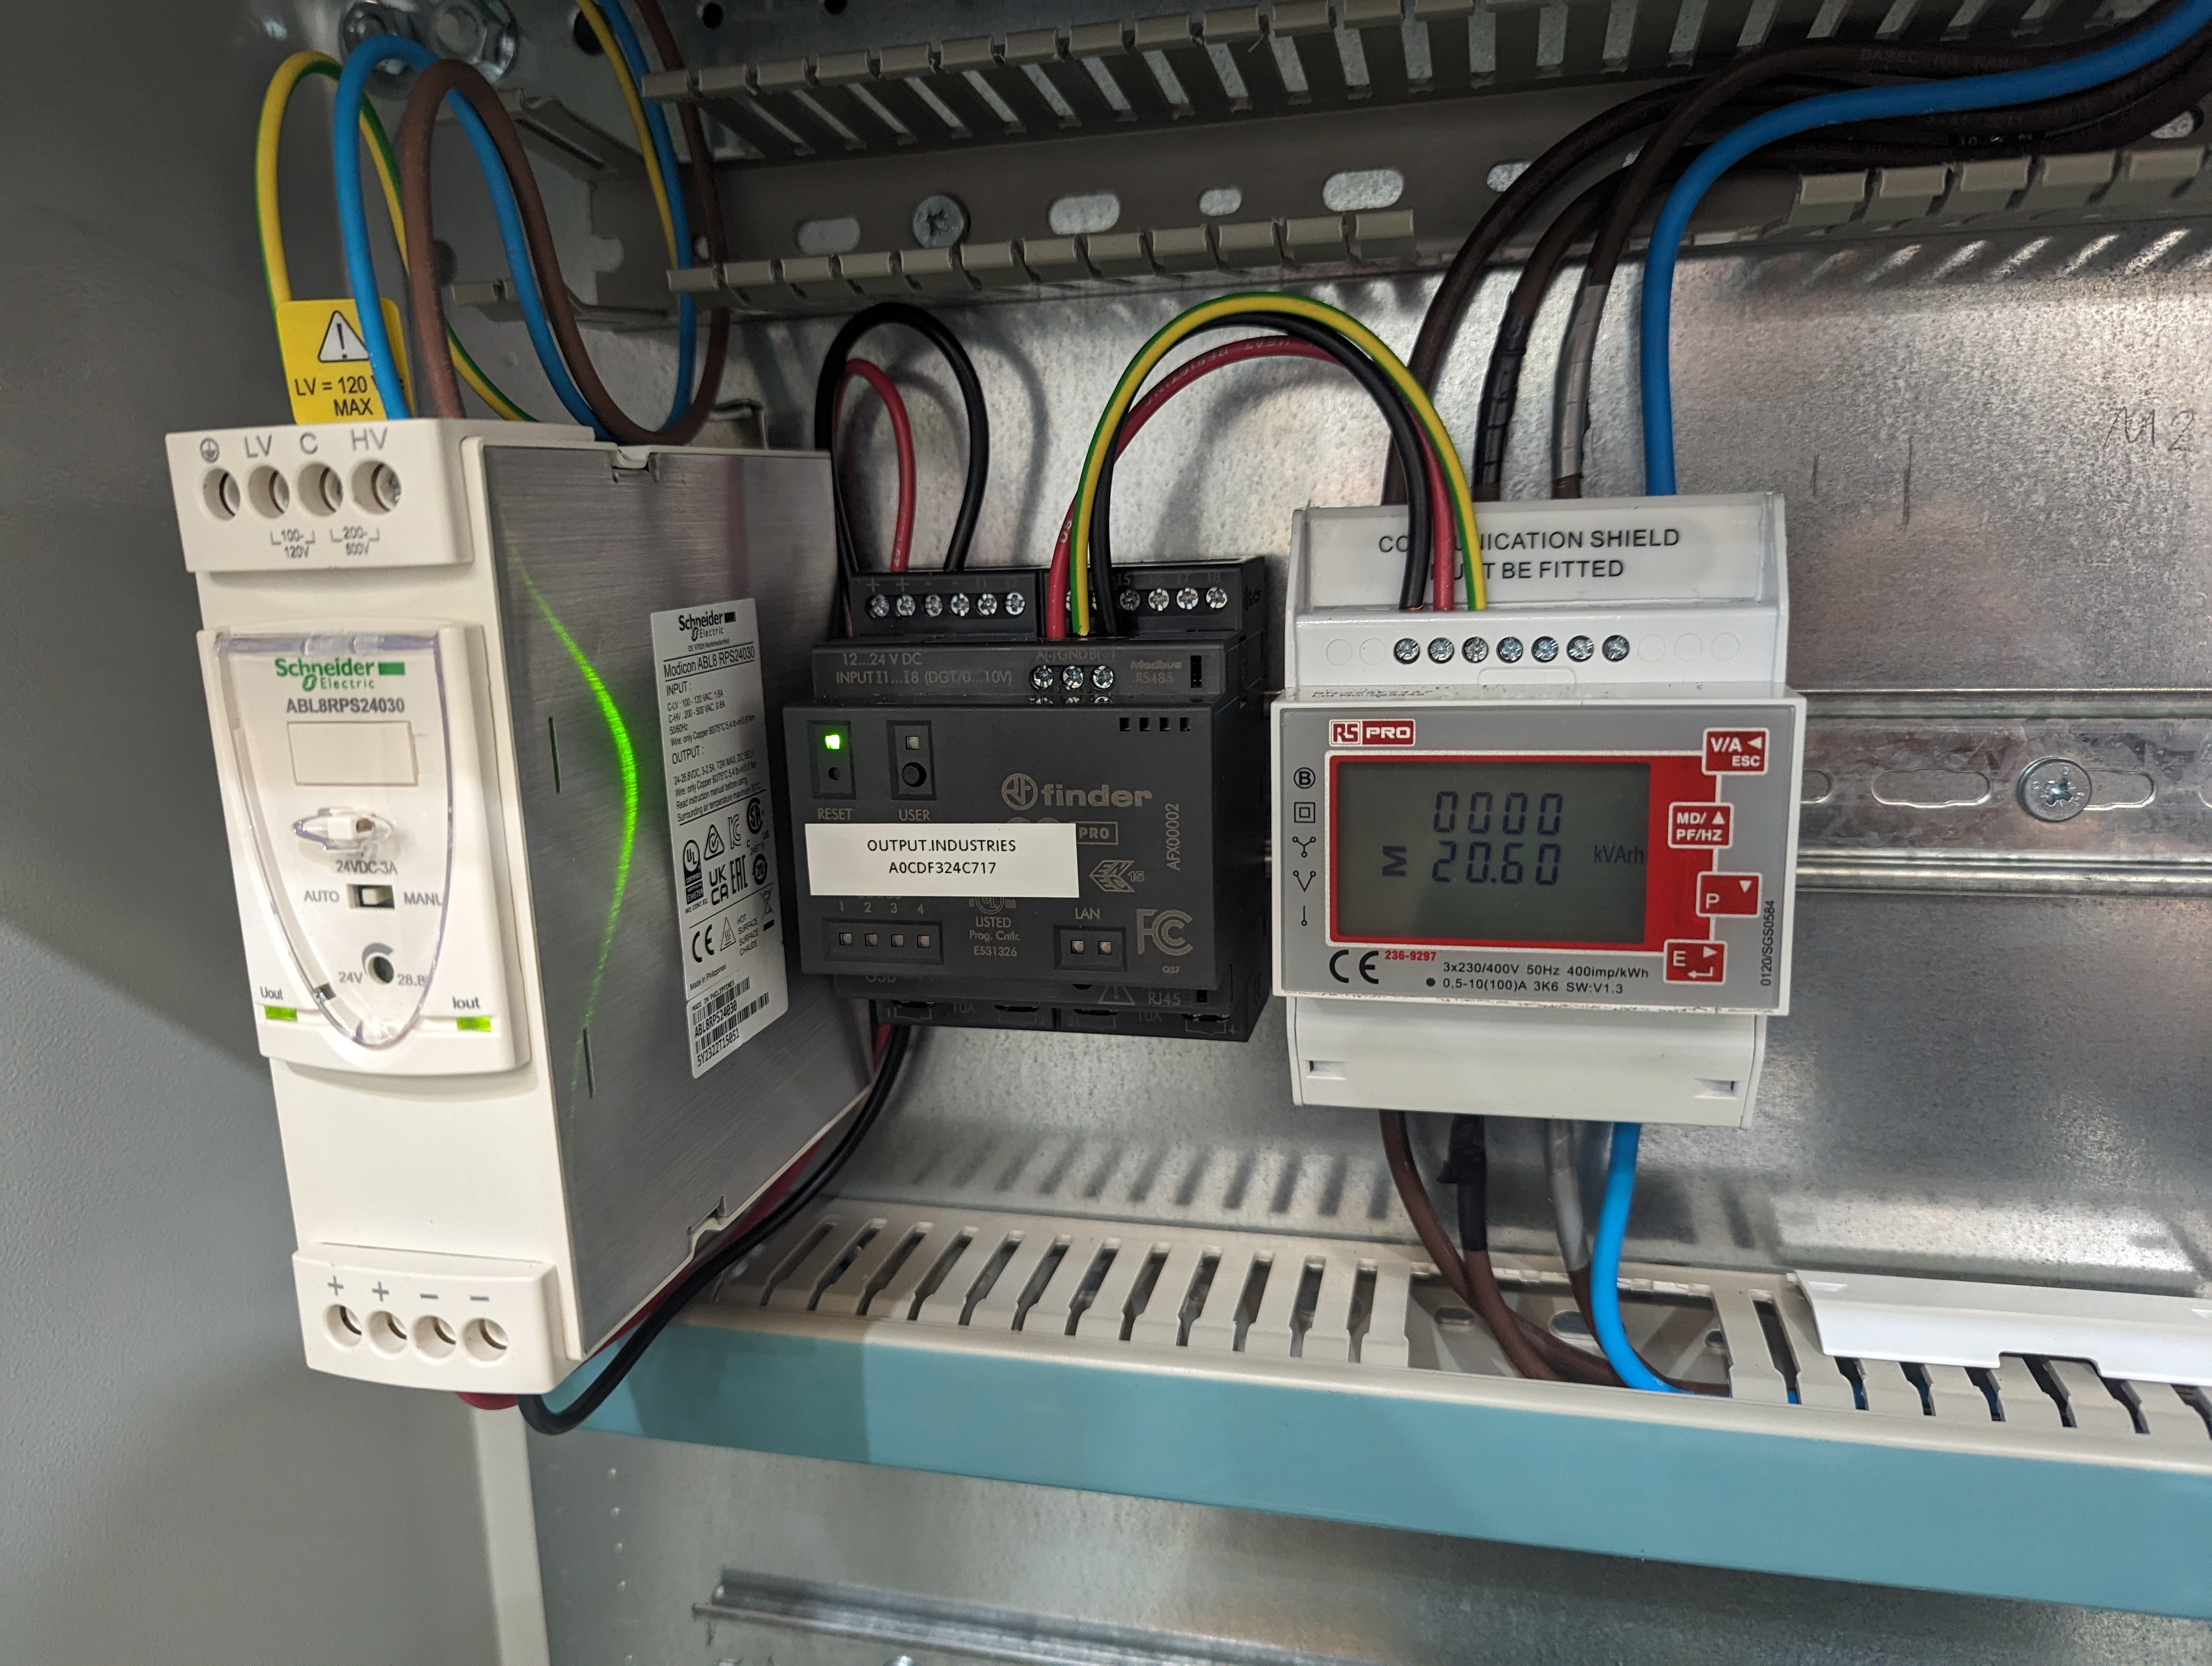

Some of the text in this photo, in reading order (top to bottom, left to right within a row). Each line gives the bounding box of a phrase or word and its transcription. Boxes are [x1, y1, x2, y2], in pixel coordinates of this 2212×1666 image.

[294, 377, 316, 396] LV
[338, 375, 367, 394] 120
[333, 398, 374, 416] MAX
[245, 427, 388, 458] LV C HV
[1590, 529, 1679, 548] SHIELD
[284, 541, 370, 558] 120V 500V
[1501, 560, 1625, 579] BE FITTED
[679, 610, 723, 631] Schneider
[699, 626, 724, 638] Electric
[274, 657, 375, 677] Schneider
[664, 645, 755, 678] Modicon ABL8 RPS24030
[890, 652, 901, 667] V
[902, 652, 922, 666] DC
[320, 677, 376, 690] Electric
[836, 670, 874, 684] INPUT
[1136, 671, 1174, 684] RS485
[666, 681, 688, 696] INPUT
[286, 697, 405, 714] ABL8RPS24030
[1332, 722, 1411, 743] RS PRO
[1710, 736, 1742, 753] V/A
[672, 745, 700, 764] OUTPUT
[1732, 755, 1761, 767] ESC
[1040, 784, 1153, 807] finder
[817, 808, 930, 822] RESET USER
[1676, 812, 1706, 825] MD/
[1078, 827, 1109, 840] PRO
[1165, 803, 1180, 871] AFX00002
[1676, 829, 1723, 842] PF/HZ
[867, 839, 1017, 853] OUTPUT.INDUSTRIES
[889, 862, 997, 875] A0CDF324C717
[1431, 840, 1561, 886] 20.60
[1594, 844, 1644, 864] kVArh
[709, 863, 727, 887] UK
[304, 890, 340, 904] AUTO
[711, 883, 729, 906] CA
[1706, 893, 1720, 909] P
[864, 902, 872, 913] 2
[890, 902, 898, 914] 3
[917, 904, 924, 914] 4
[1075, 907, 1100, 920] LAN
[737, 913, 747, 925] HOT
[975, 917, 1012, 928] LISTED
[969, 930, 993, 942] Prog.
[1760, 900, 1776, 986] 0120/SGS0584
[973, 945, 1018, 957] E531326
[1385, 950, 1437, 962] 236-9297
[1673, 950, 1686, 967] E
[338, 971, 363, 984] 24V
[690, 978, 702, 990] Made
[706, 963, 726, 981] Philippines
[1443, 962, 1649, 979] 3x230/400V 50Hz 400imp/kWh
[710, 979, 735, 999] PHILIPPINES
[1533, 981, 1559, 992] 3K6
[260, 985, 480, 1010] Uout Iout
[1148, 991, 1181, 1005] RJ45
[695, 999, 737, 1039] ABL8RPS24030
